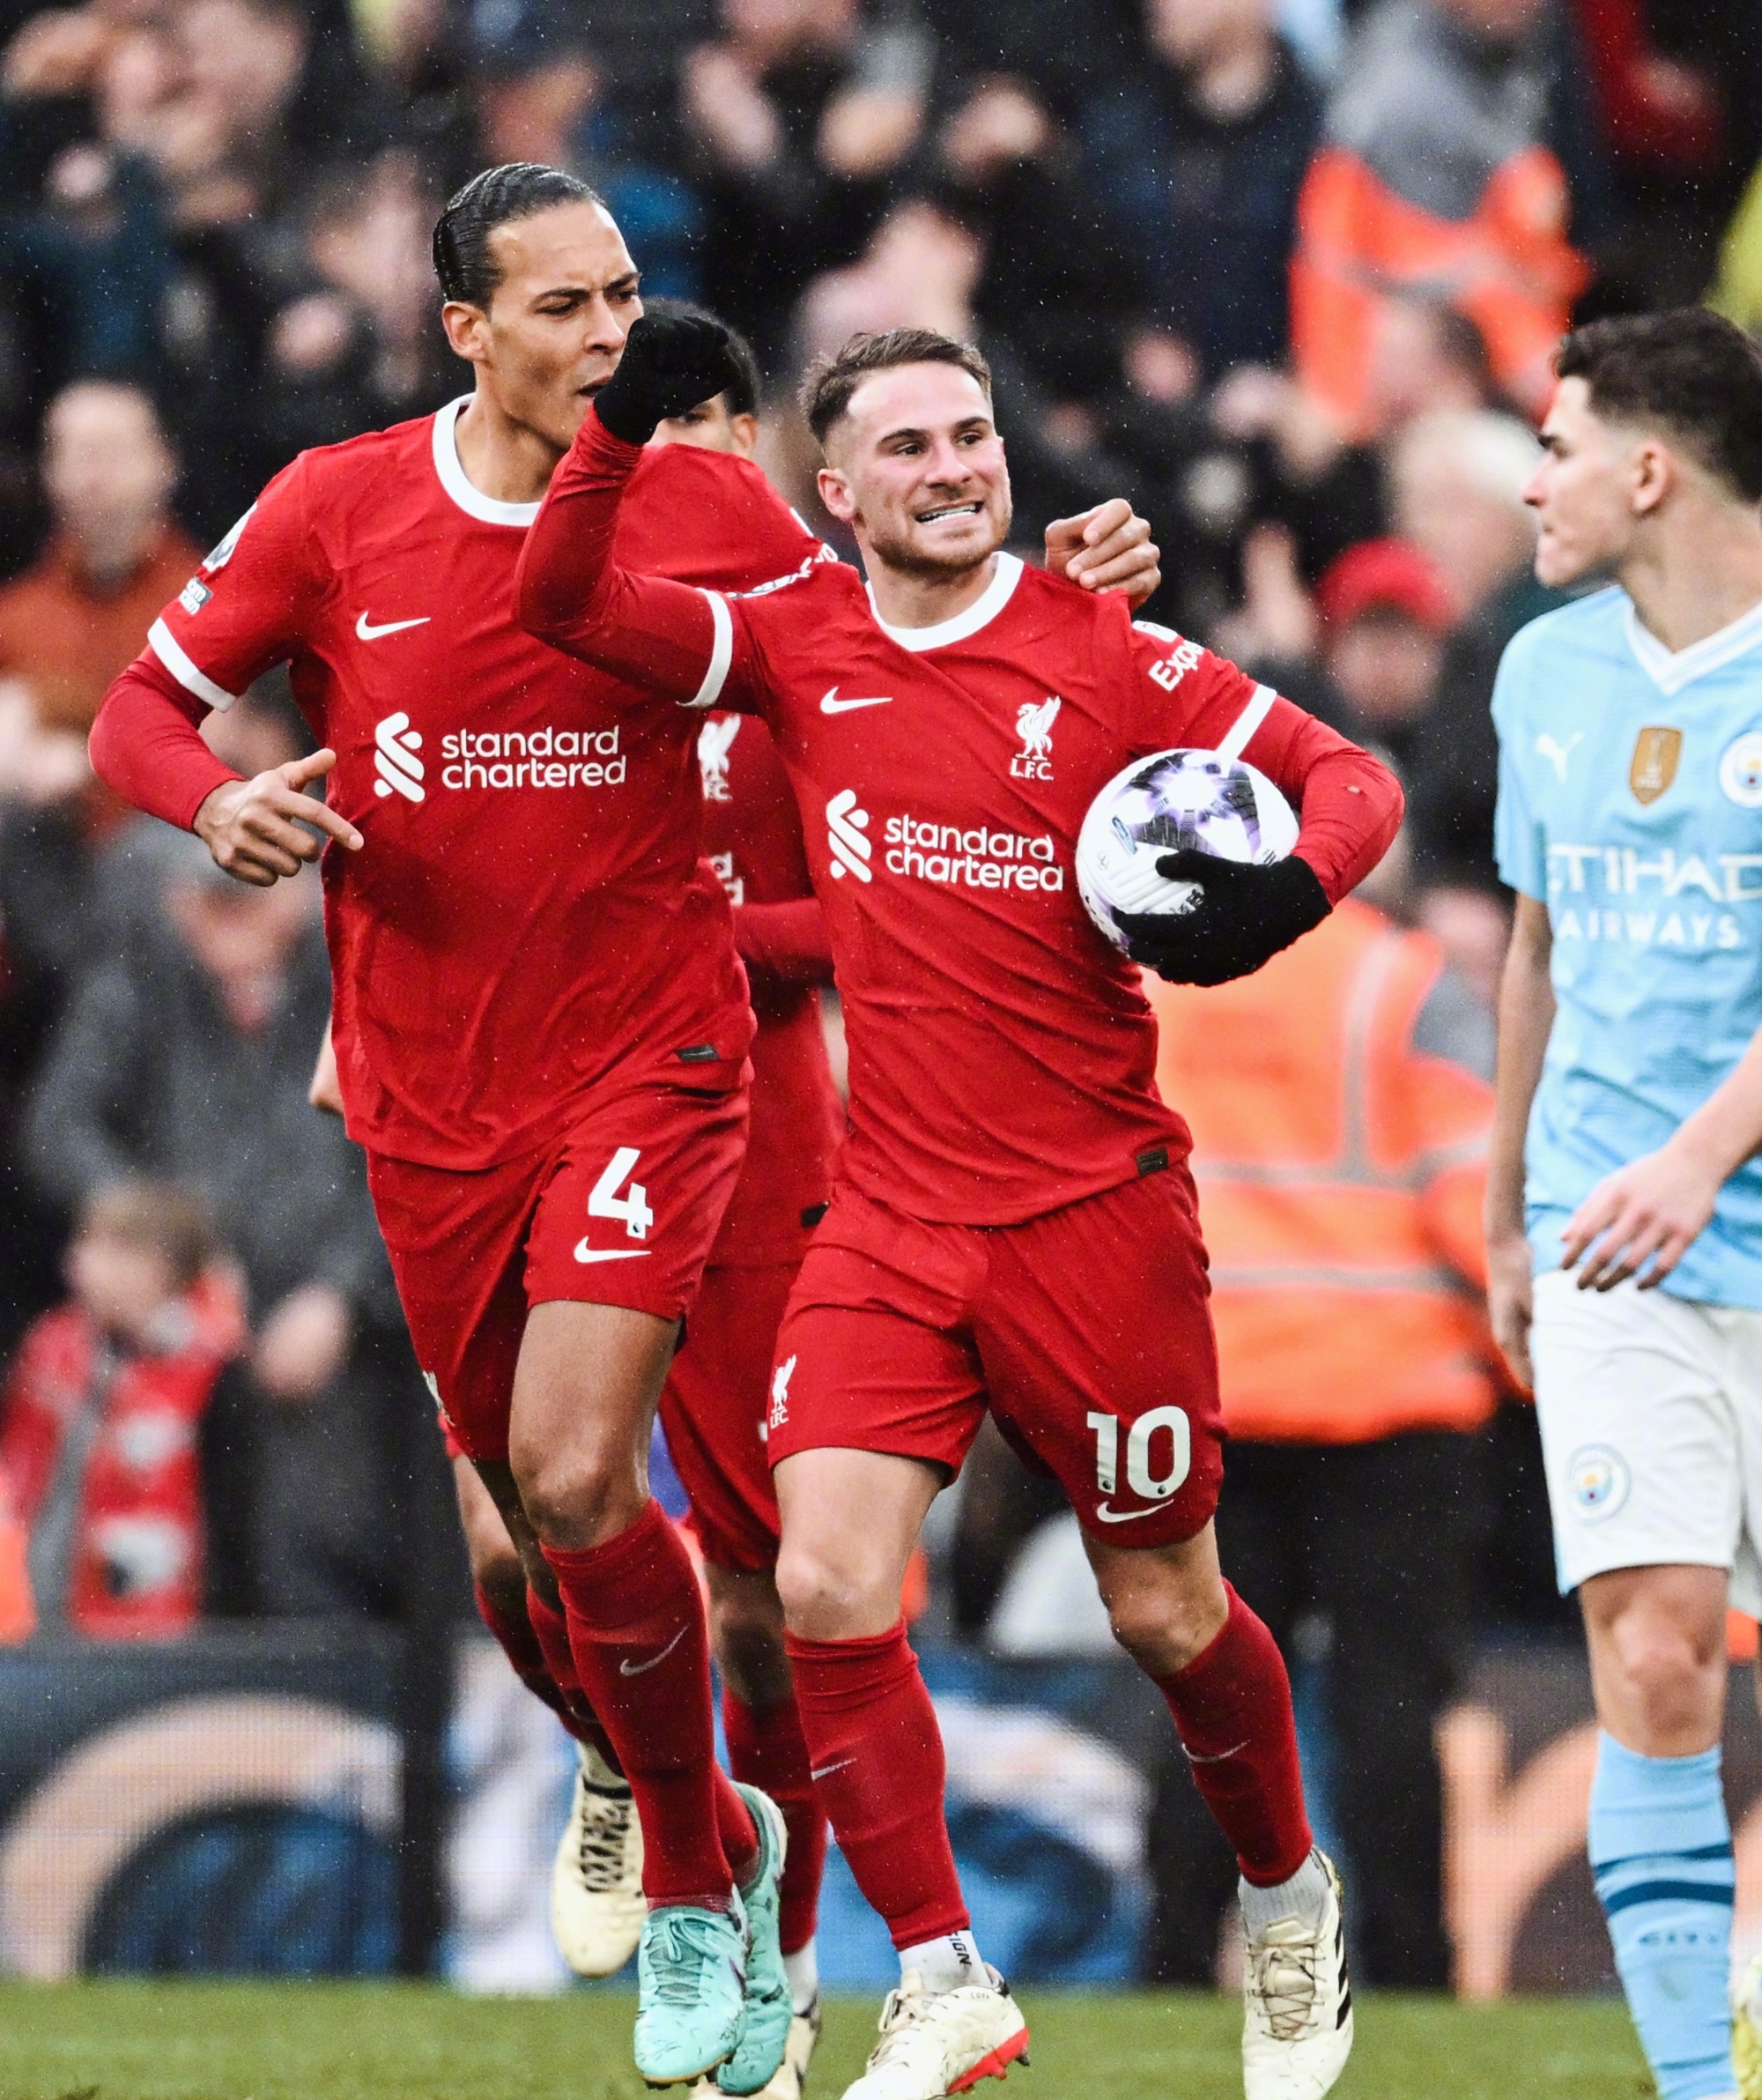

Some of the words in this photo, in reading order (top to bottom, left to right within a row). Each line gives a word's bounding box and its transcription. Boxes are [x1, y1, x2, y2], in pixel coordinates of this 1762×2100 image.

[441, 724, 619, 759] standard
[441, 755, 627, 790] chartered
[884, 813, 1055, 863] standard
[885, 846, 1063, 892] chartered
[1556, 909, 1741, 949] AIRWAYS
[588, 1146, 654, 1240] 4
[1086, 1405, 1191, 1499] 10
